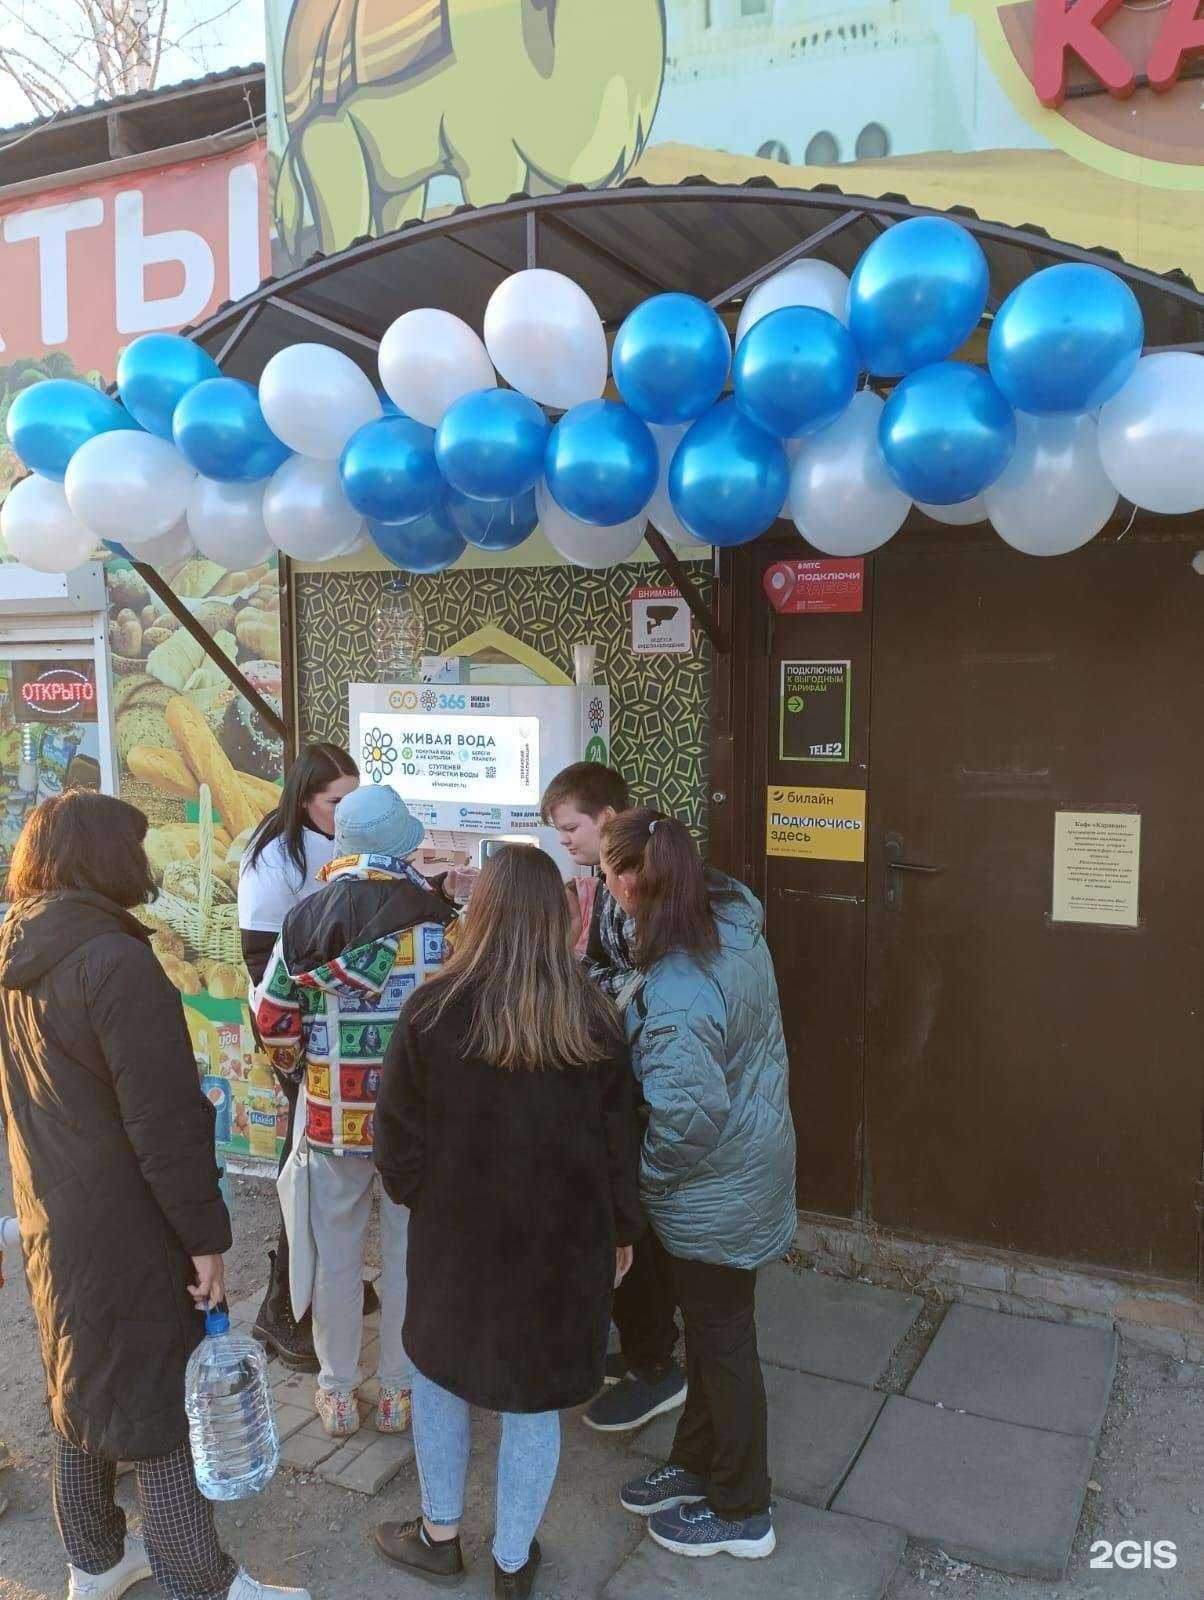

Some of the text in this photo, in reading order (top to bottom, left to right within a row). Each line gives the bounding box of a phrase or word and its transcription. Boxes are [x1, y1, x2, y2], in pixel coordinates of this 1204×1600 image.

[0, 162, 262, 352] ТЫ
[787, 666, 843, 676] ПОДКЛЮЧИМ
[795, 676, 844, 684] ВЫГОДНЫМ
[22, 683, 94, 701] ОТКРЫТО
[438, 694, 466, 709] 365
[401, 732, 496, 748] ЖИВАЯ ВОДА
[809, 742, 842, 756] TELE2
[401, 763, 415, 775] 10
[428, 763, 461, 771] СТУПЕНЕЙ
[428, 770, 479, 779] ОЧИСТКИ ВОДЫ
[787, 791, 834, 805] билайн
[771, 812, 862, 830] Подключись
[771, 830, 812, 843] здесь
